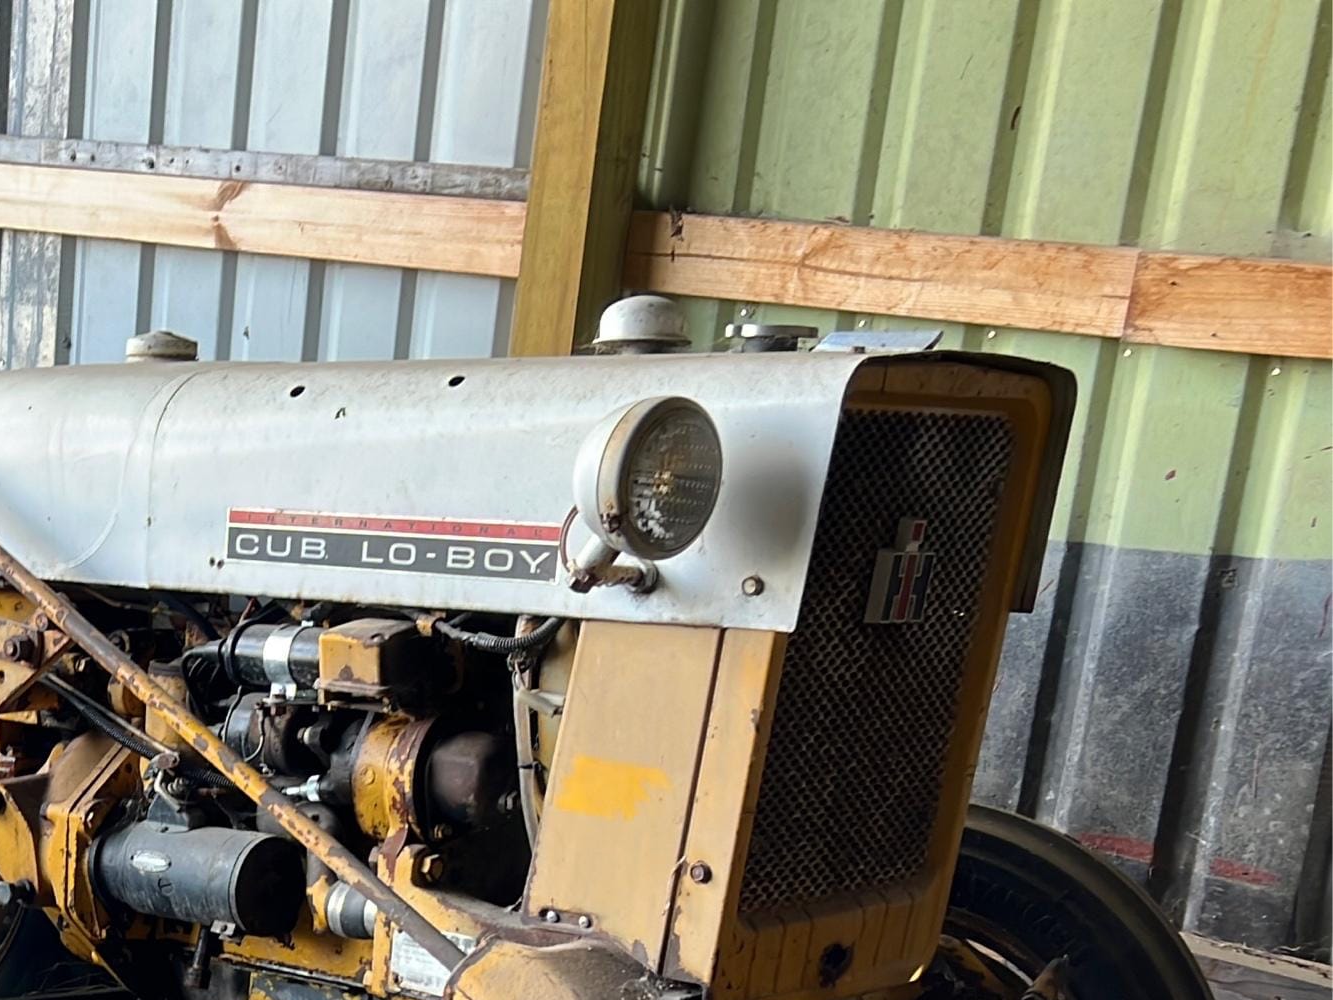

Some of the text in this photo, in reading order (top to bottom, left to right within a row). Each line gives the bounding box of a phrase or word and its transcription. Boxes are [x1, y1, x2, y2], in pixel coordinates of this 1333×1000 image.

[246, 513, 544, 537] INTERNATIONAL
[235, 534, 551, 574] CUB LO-BOY
